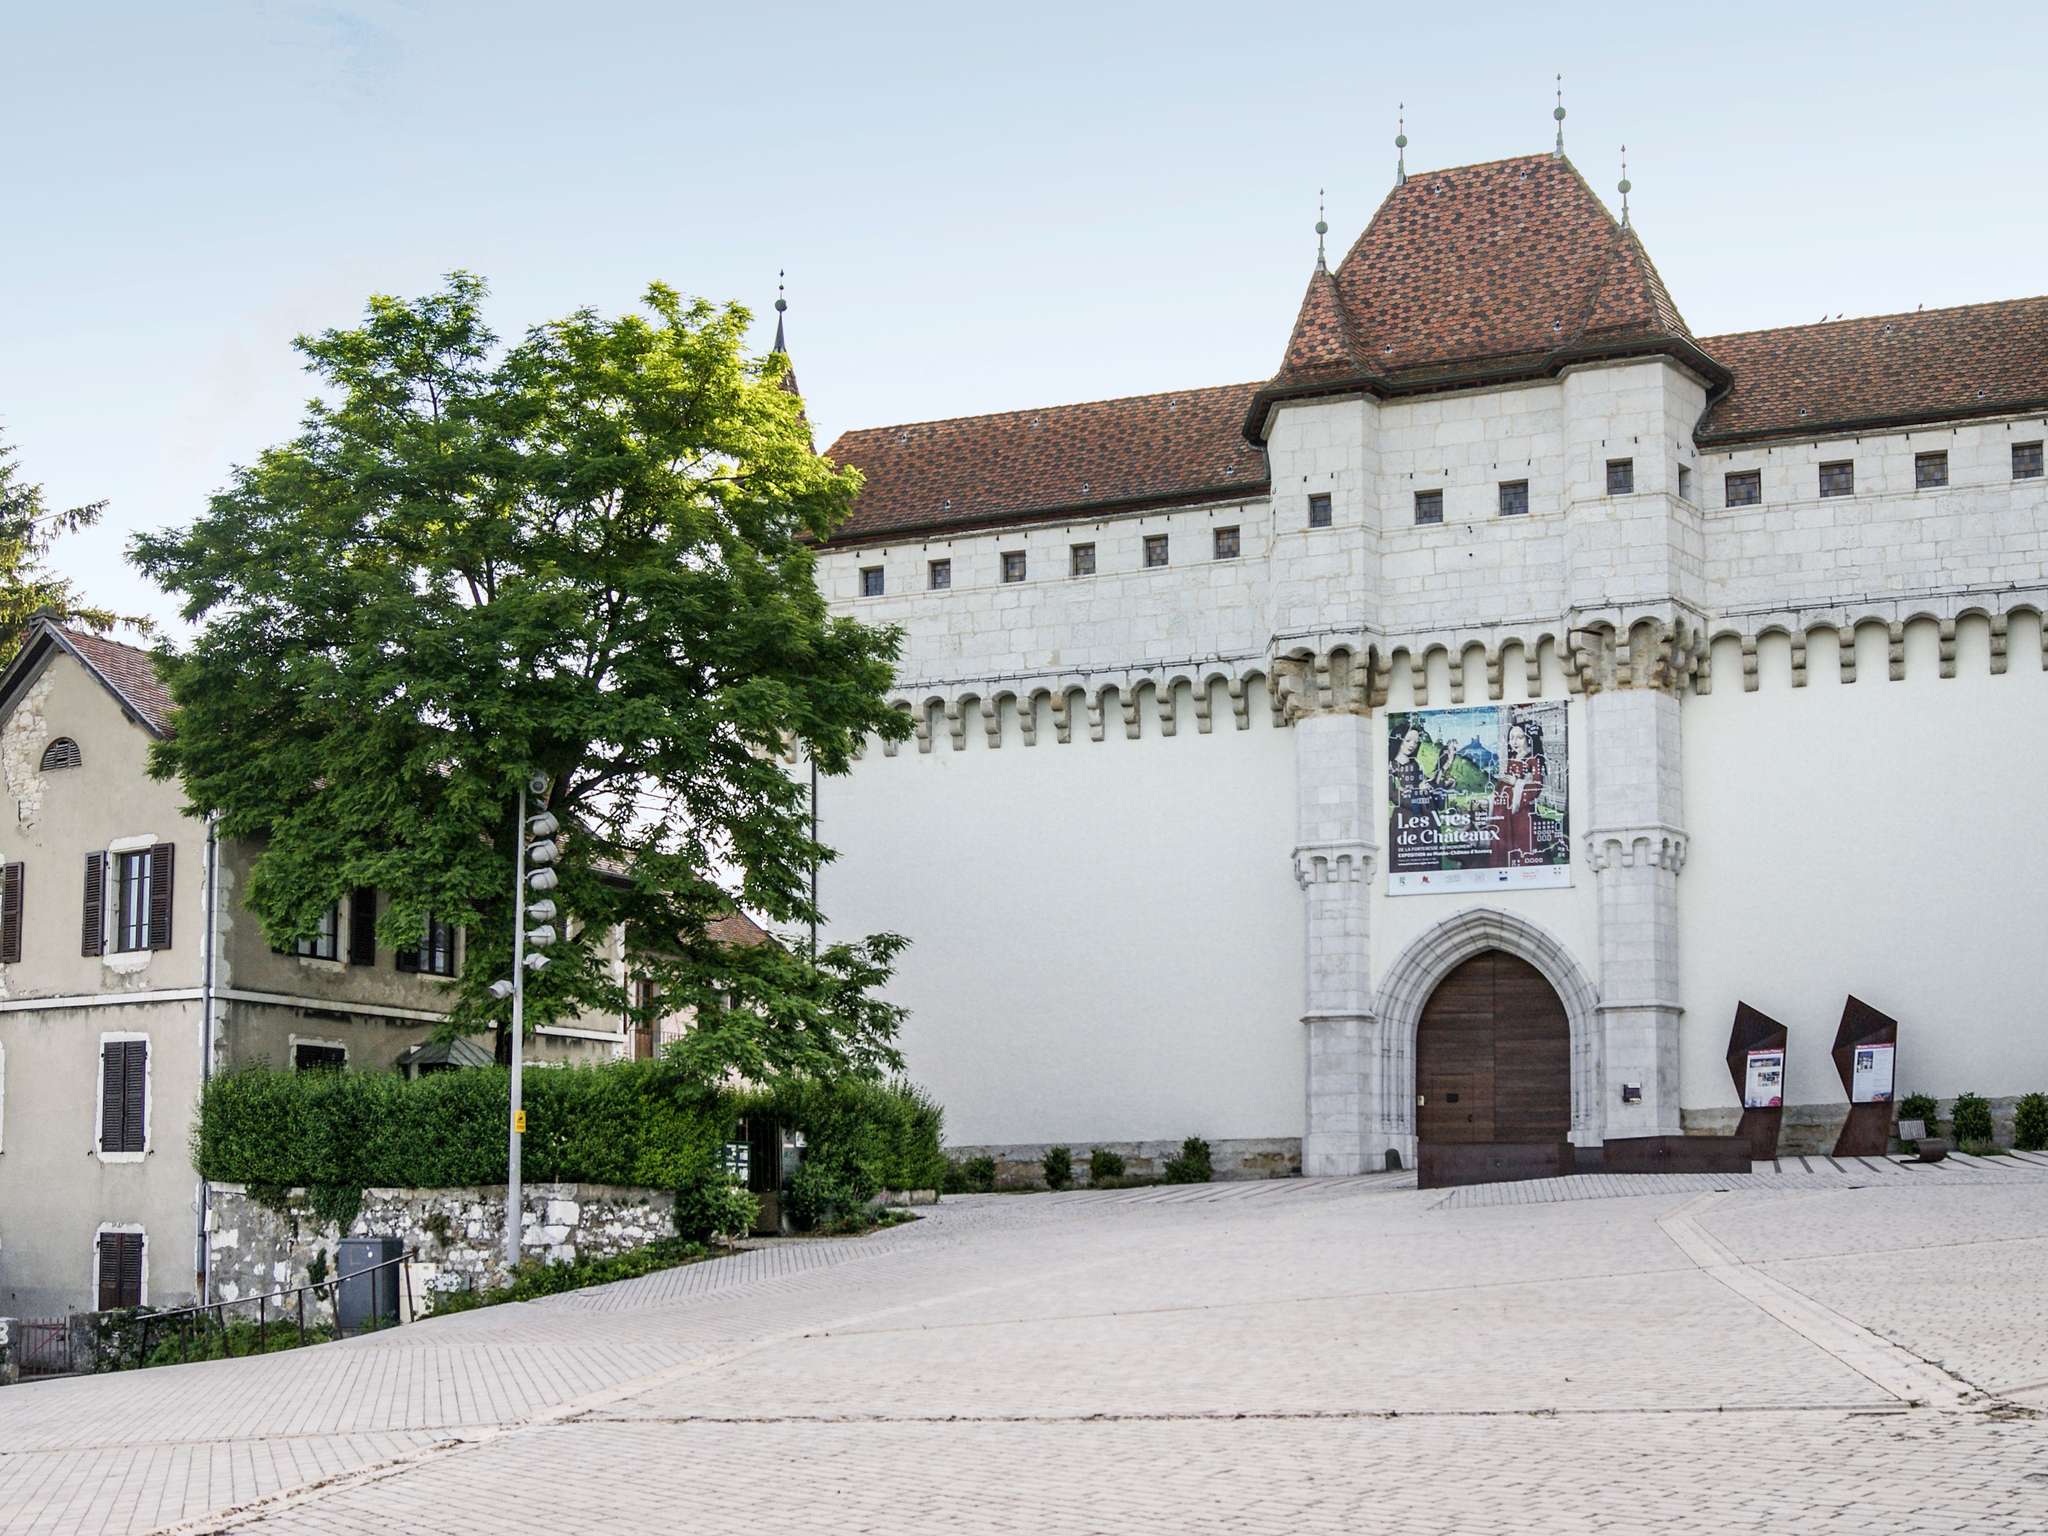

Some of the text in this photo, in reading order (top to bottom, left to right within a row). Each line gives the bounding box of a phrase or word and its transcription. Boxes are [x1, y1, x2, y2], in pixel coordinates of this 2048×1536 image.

[1397, 808, 1471, 829] Les Vies
[1397, 825, 1500, 845] de Châteaux
